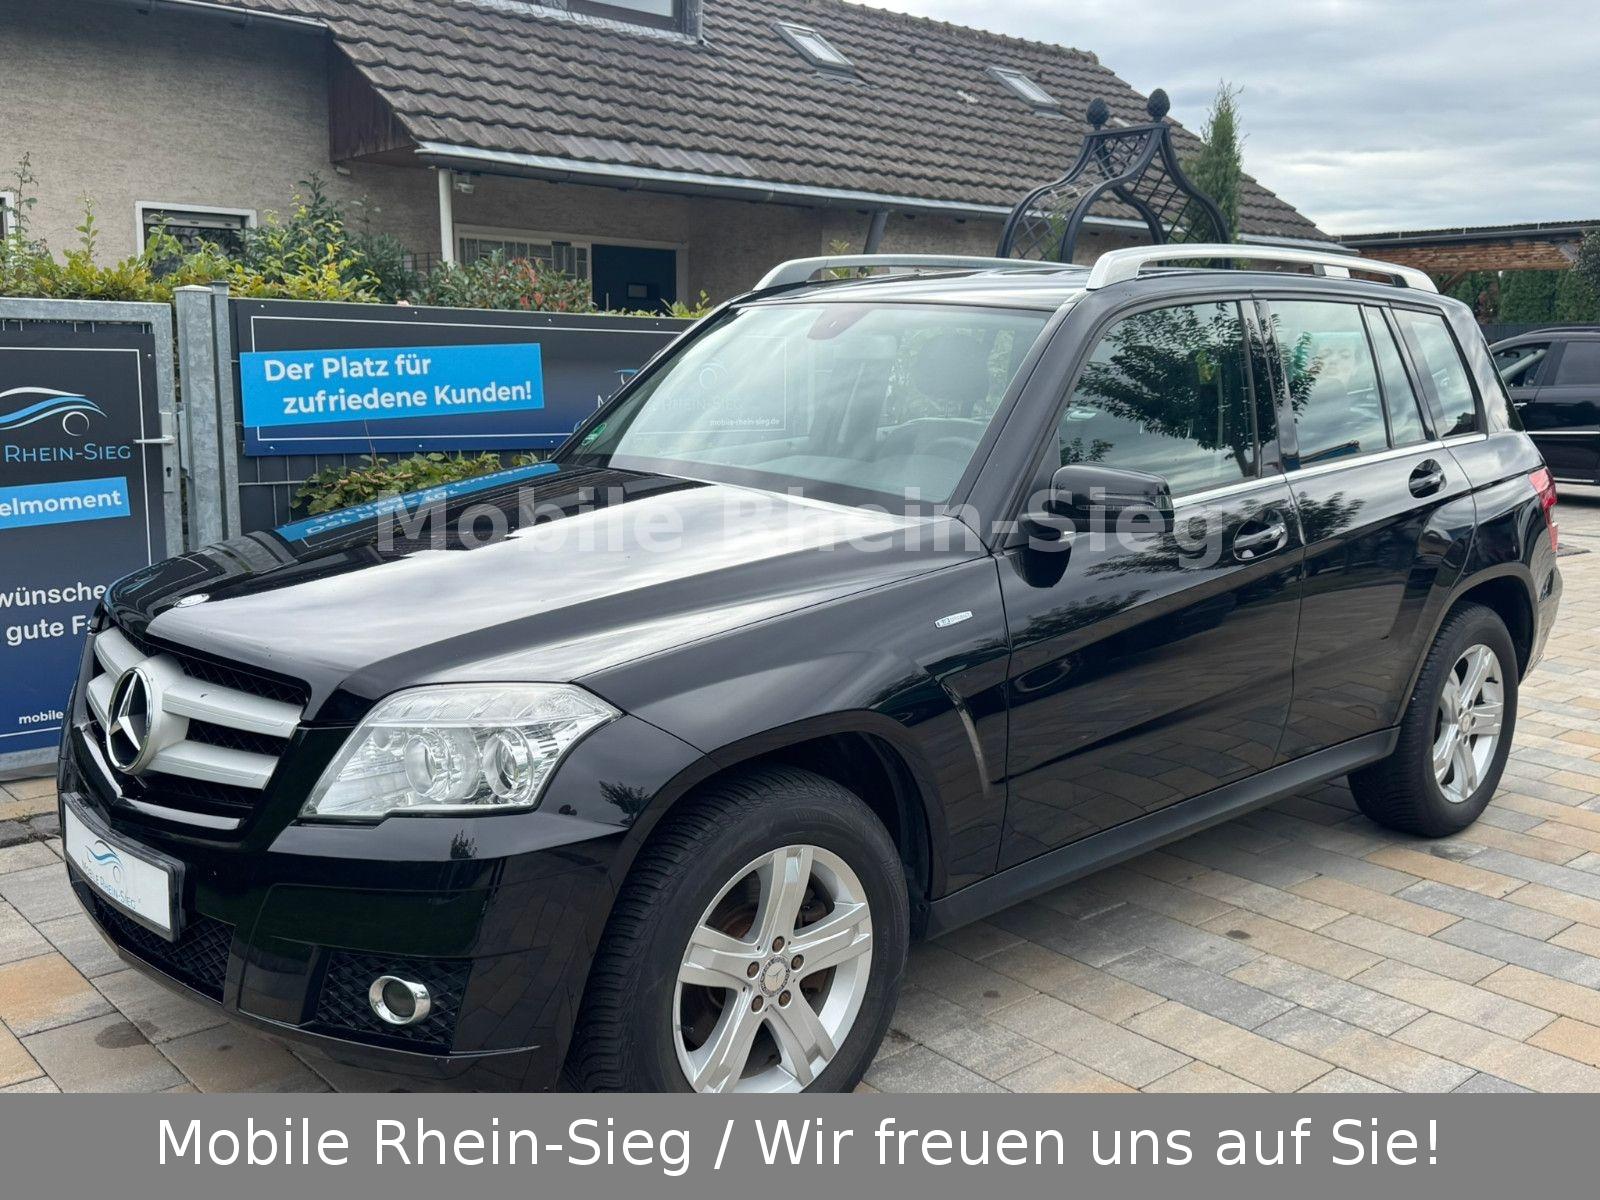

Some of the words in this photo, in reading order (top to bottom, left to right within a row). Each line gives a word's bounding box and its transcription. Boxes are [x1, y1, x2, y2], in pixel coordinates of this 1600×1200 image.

[264, 358, 314, 382] Der
[322, 354, 389, 379] Platz
[394, 353, 432, 376] für
[283, 387, 428, 415] zufriedene
[434, 380, 532, 405] Kunden!
[4, 443, 131, 463] RHEIN-SIEG
[6, 619, 64, 647] gute
